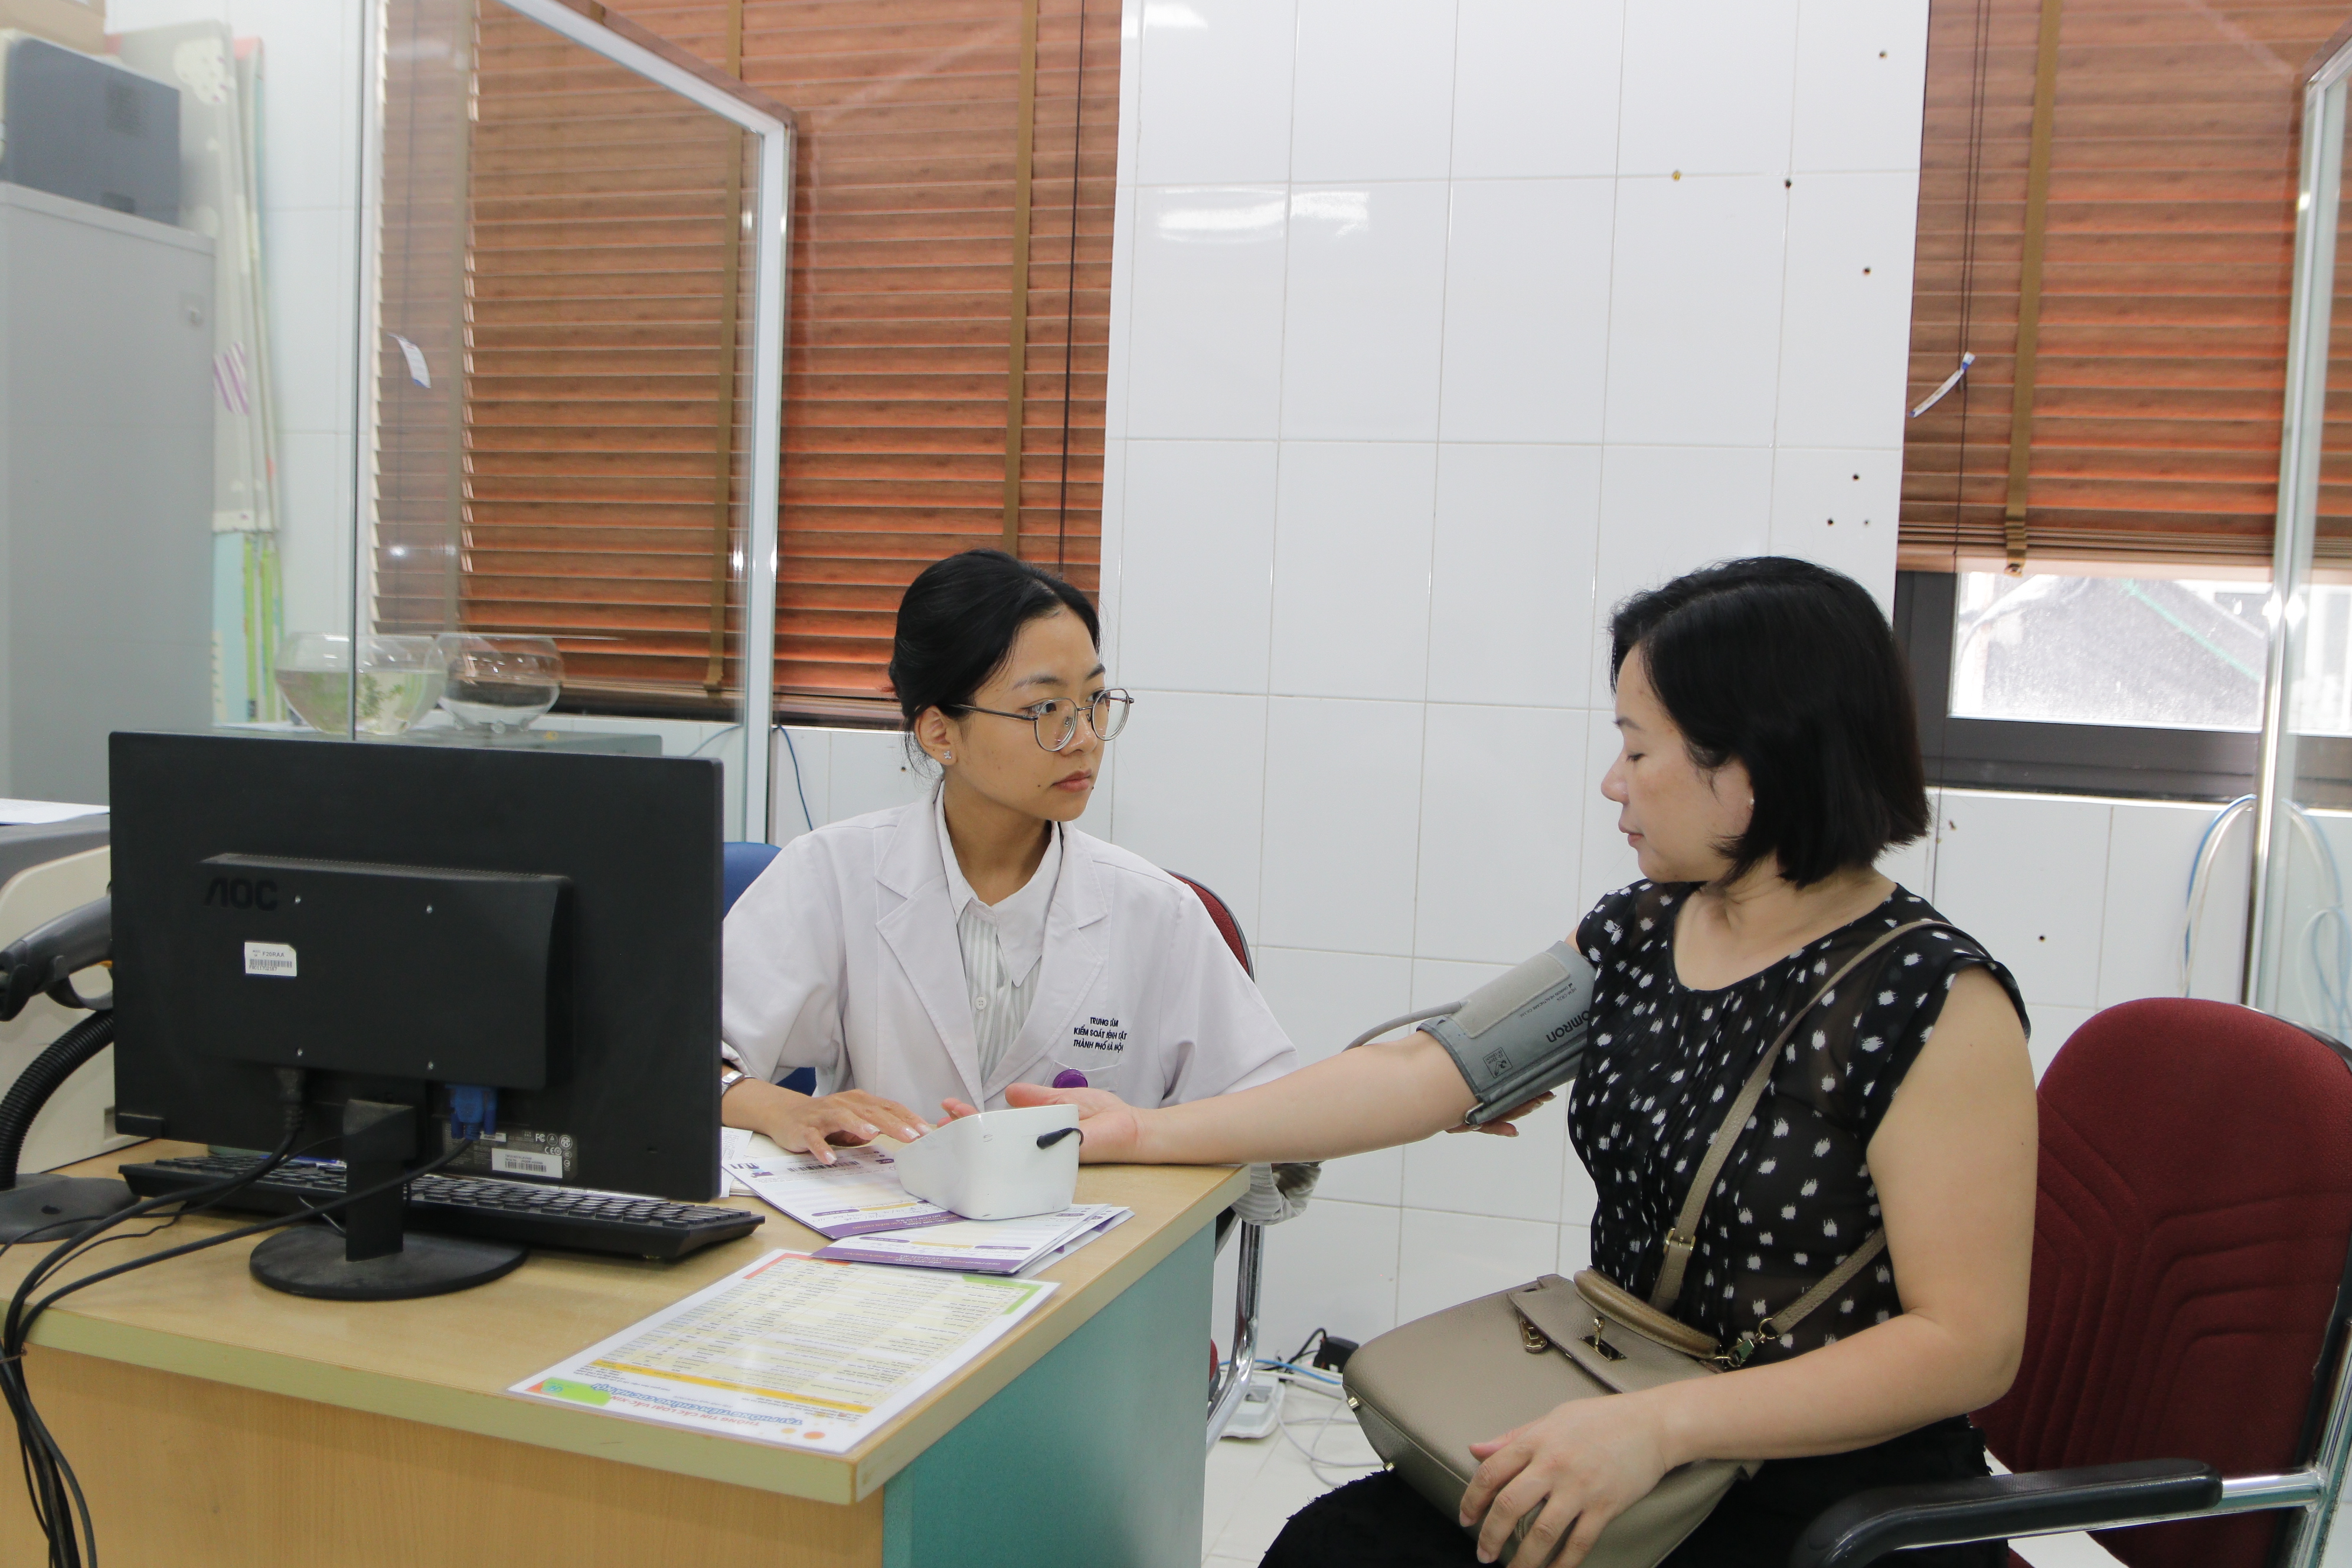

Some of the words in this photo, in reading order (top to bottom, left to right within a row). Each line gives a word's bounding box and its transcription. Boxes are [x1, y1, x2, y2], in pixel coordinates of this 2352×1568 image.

[1090, 1017, 1109, 1026] TRUNG
[1546, 1010, 1589, 1043] OMRON
[1074, 1024, 1089, 1036] KIỂM
[1090, 1029, 1105, 1038] SOÁT
[1106, 1030, 1118, 1041] BỆNH
[1073, 1038, 1094, 1048] THÀNH
[1095, 1040, 1108, 1050] PHỐ
[1107, 1042, 1113, 1051] HÀ
[1113, 1043, 1124, 1053] NỘI
[591, 1383, 614, 1391] NỘI
[610, 1396, 650, 1407] VẮC-XIN
[629, 1393, 656, 1402] CDC
[698, 1406, 730, 1415] TIÊM
[721, 1417, 759, 1426] THÔNG
[778, 1417, 803, 1425] TẠI
